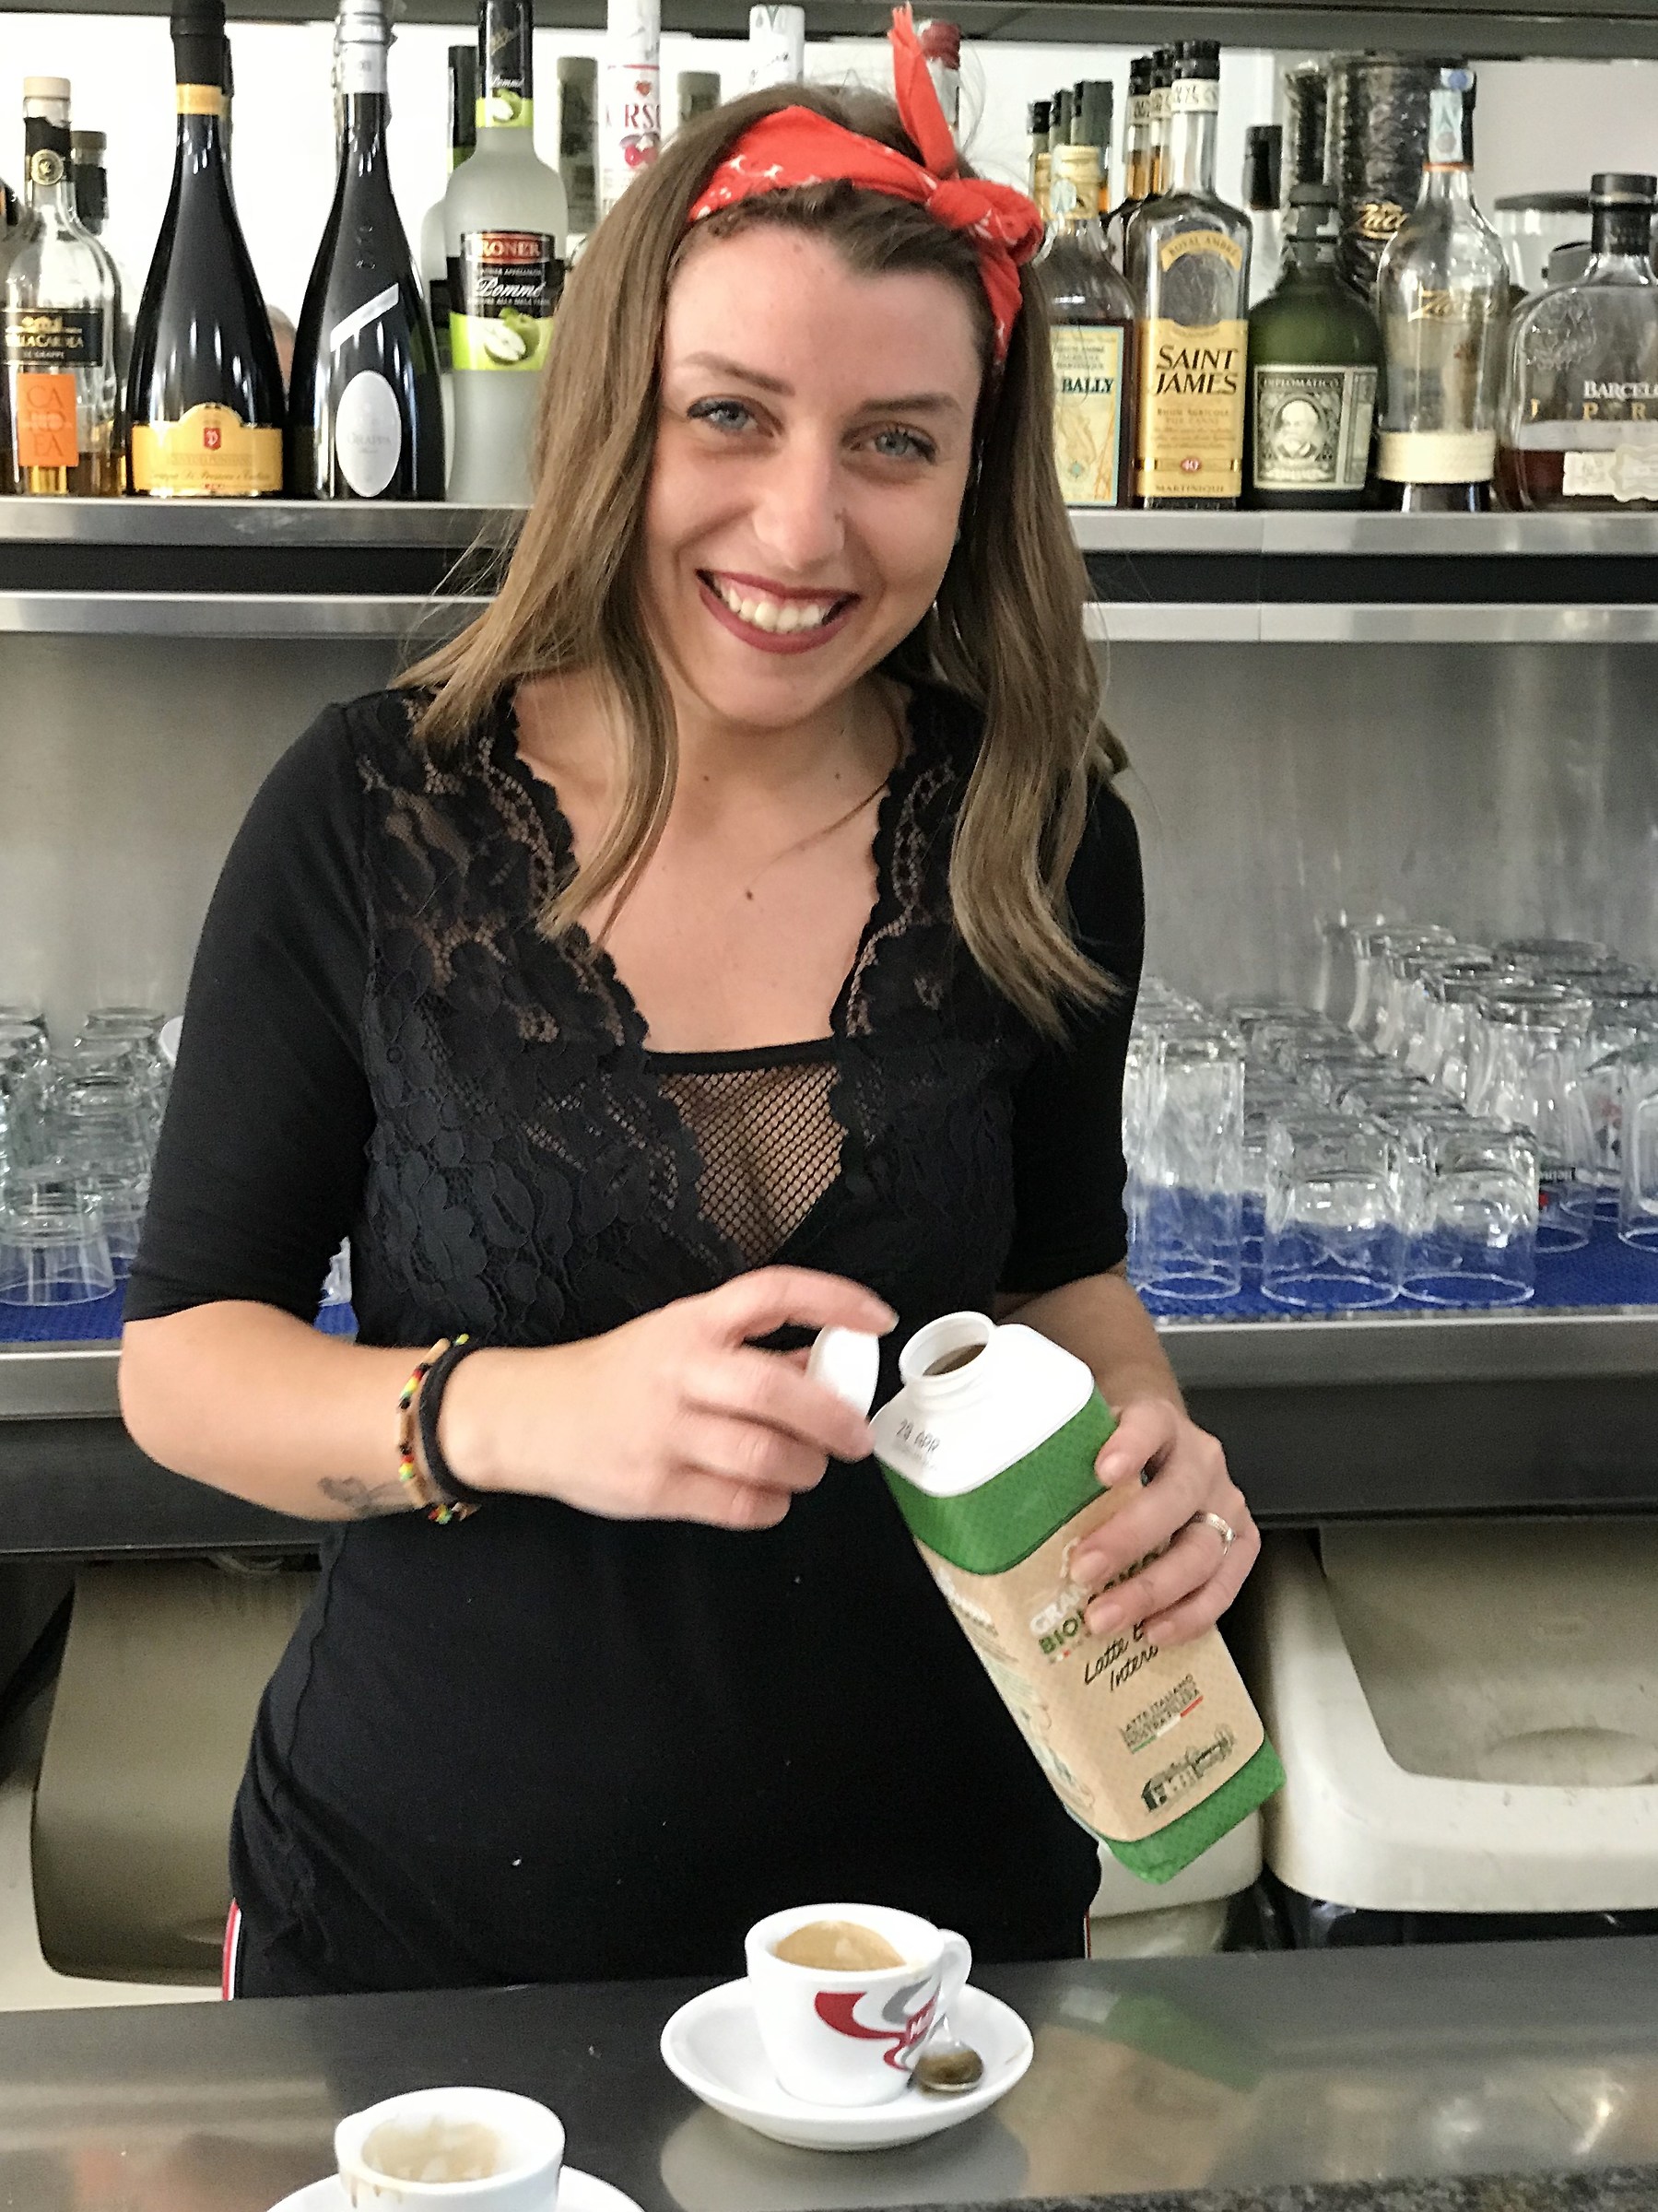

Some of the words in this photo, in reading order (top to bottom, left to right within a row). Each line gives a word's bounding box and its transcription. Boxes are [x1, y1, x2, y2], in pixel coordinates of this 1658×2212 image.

[1157, 344, 1239, 371] SAINT
[1061, 376, 1114, 394] BALLY
[1154, 372, 1239, 396] JAMES
[1085, 1636, 1129, 1686] Latte
